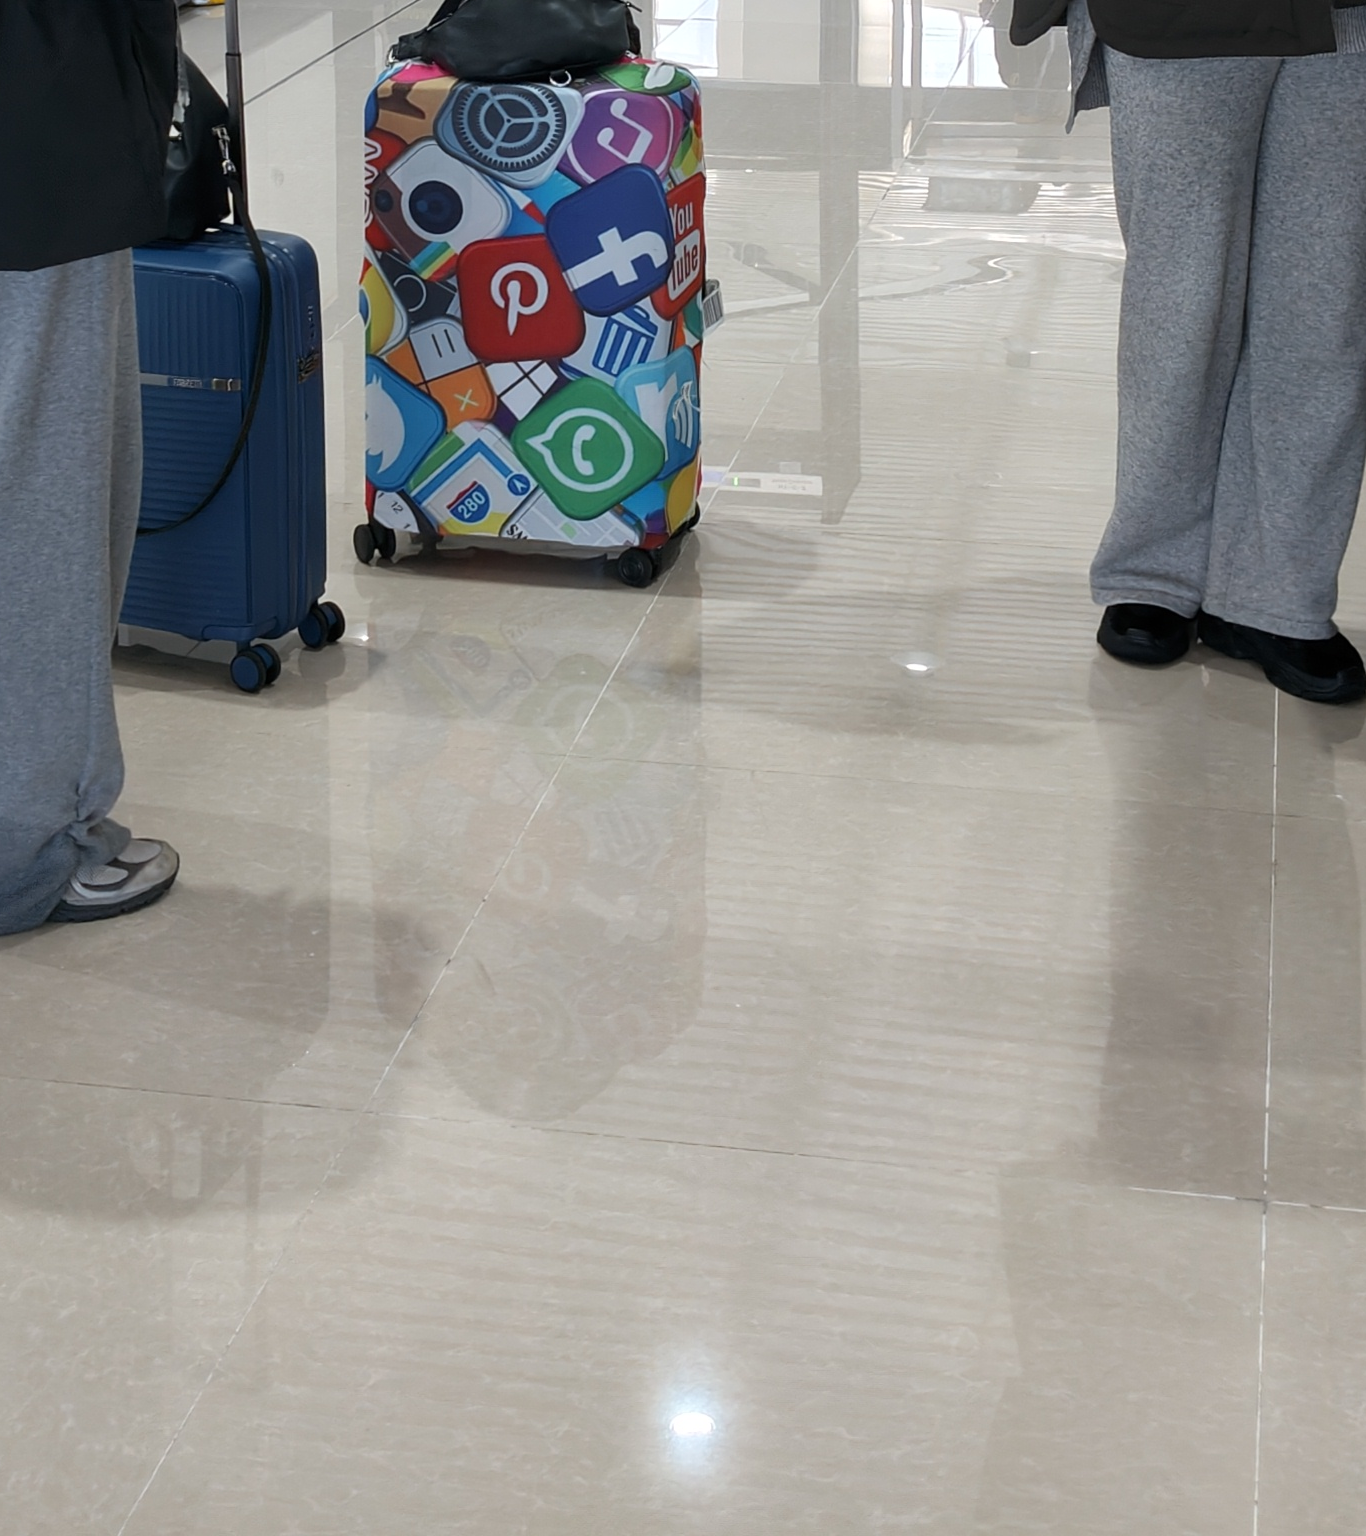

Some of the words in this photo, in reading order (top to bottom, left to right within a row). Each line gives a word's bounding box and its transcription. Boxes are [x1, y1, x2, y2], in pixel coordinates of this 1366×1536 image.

[669, 202, 694, 240] You
[390, 501, 404, 514] 12
[457, 490, 486, 520] 280
